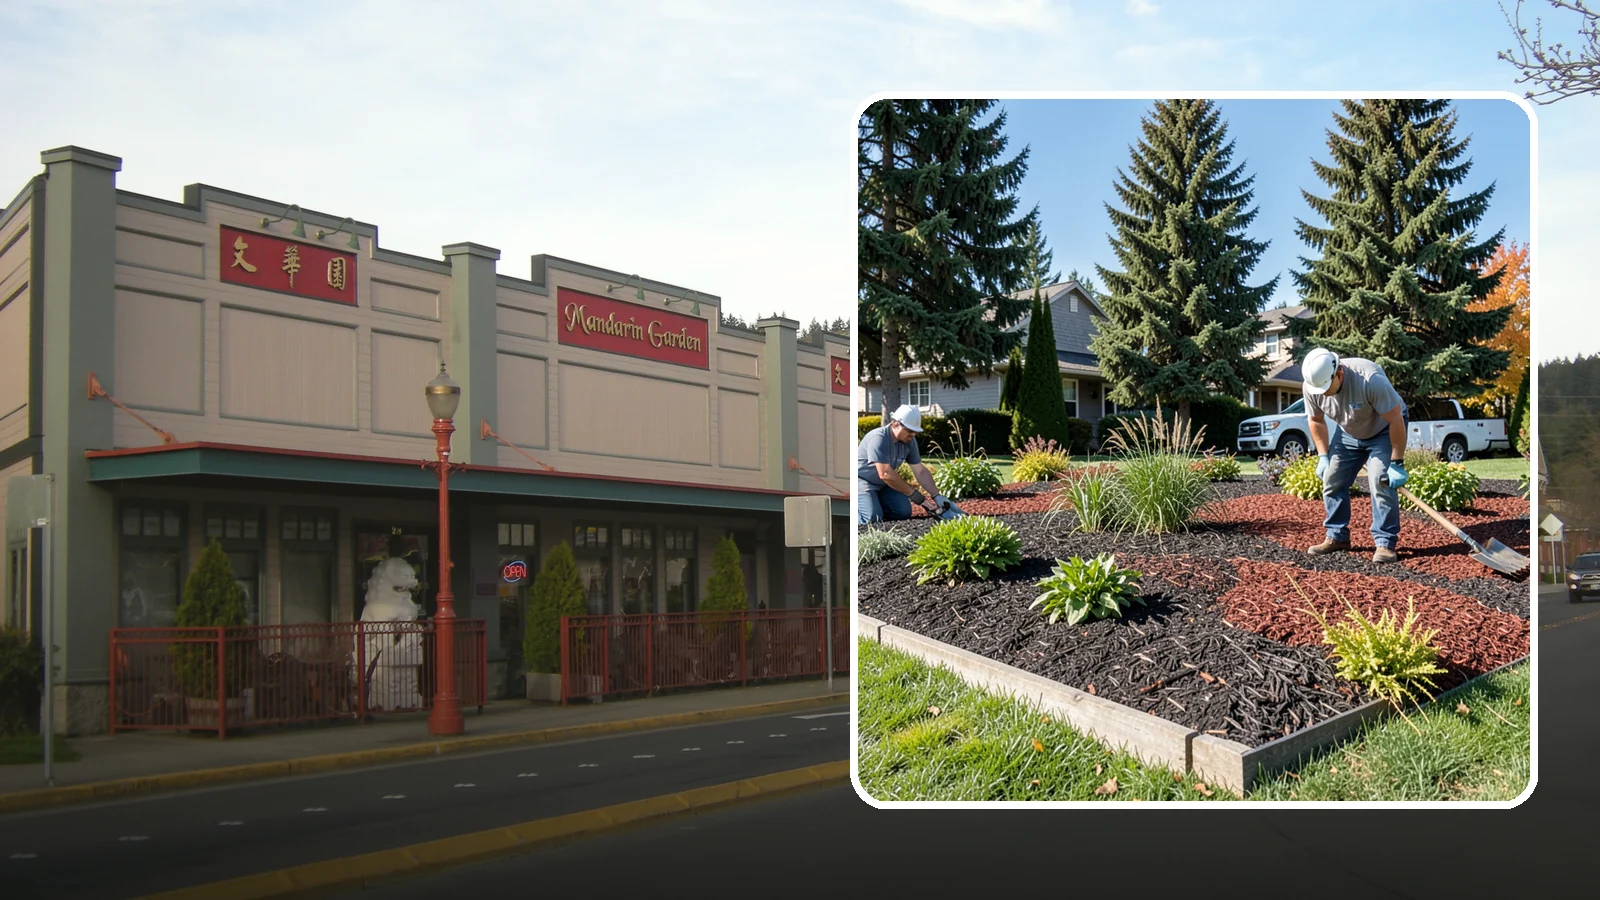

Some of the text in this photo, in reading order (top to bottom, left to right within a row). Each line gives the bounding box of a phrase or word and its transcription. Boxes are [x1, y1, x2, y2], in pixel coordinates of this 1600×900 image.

[231, 236, 346, 290] 文華園
[564, 302, 702, 351] Mandarin Garden
[835, 363, 846, 386] 文
[503, 565, 527, 578] OPEN
